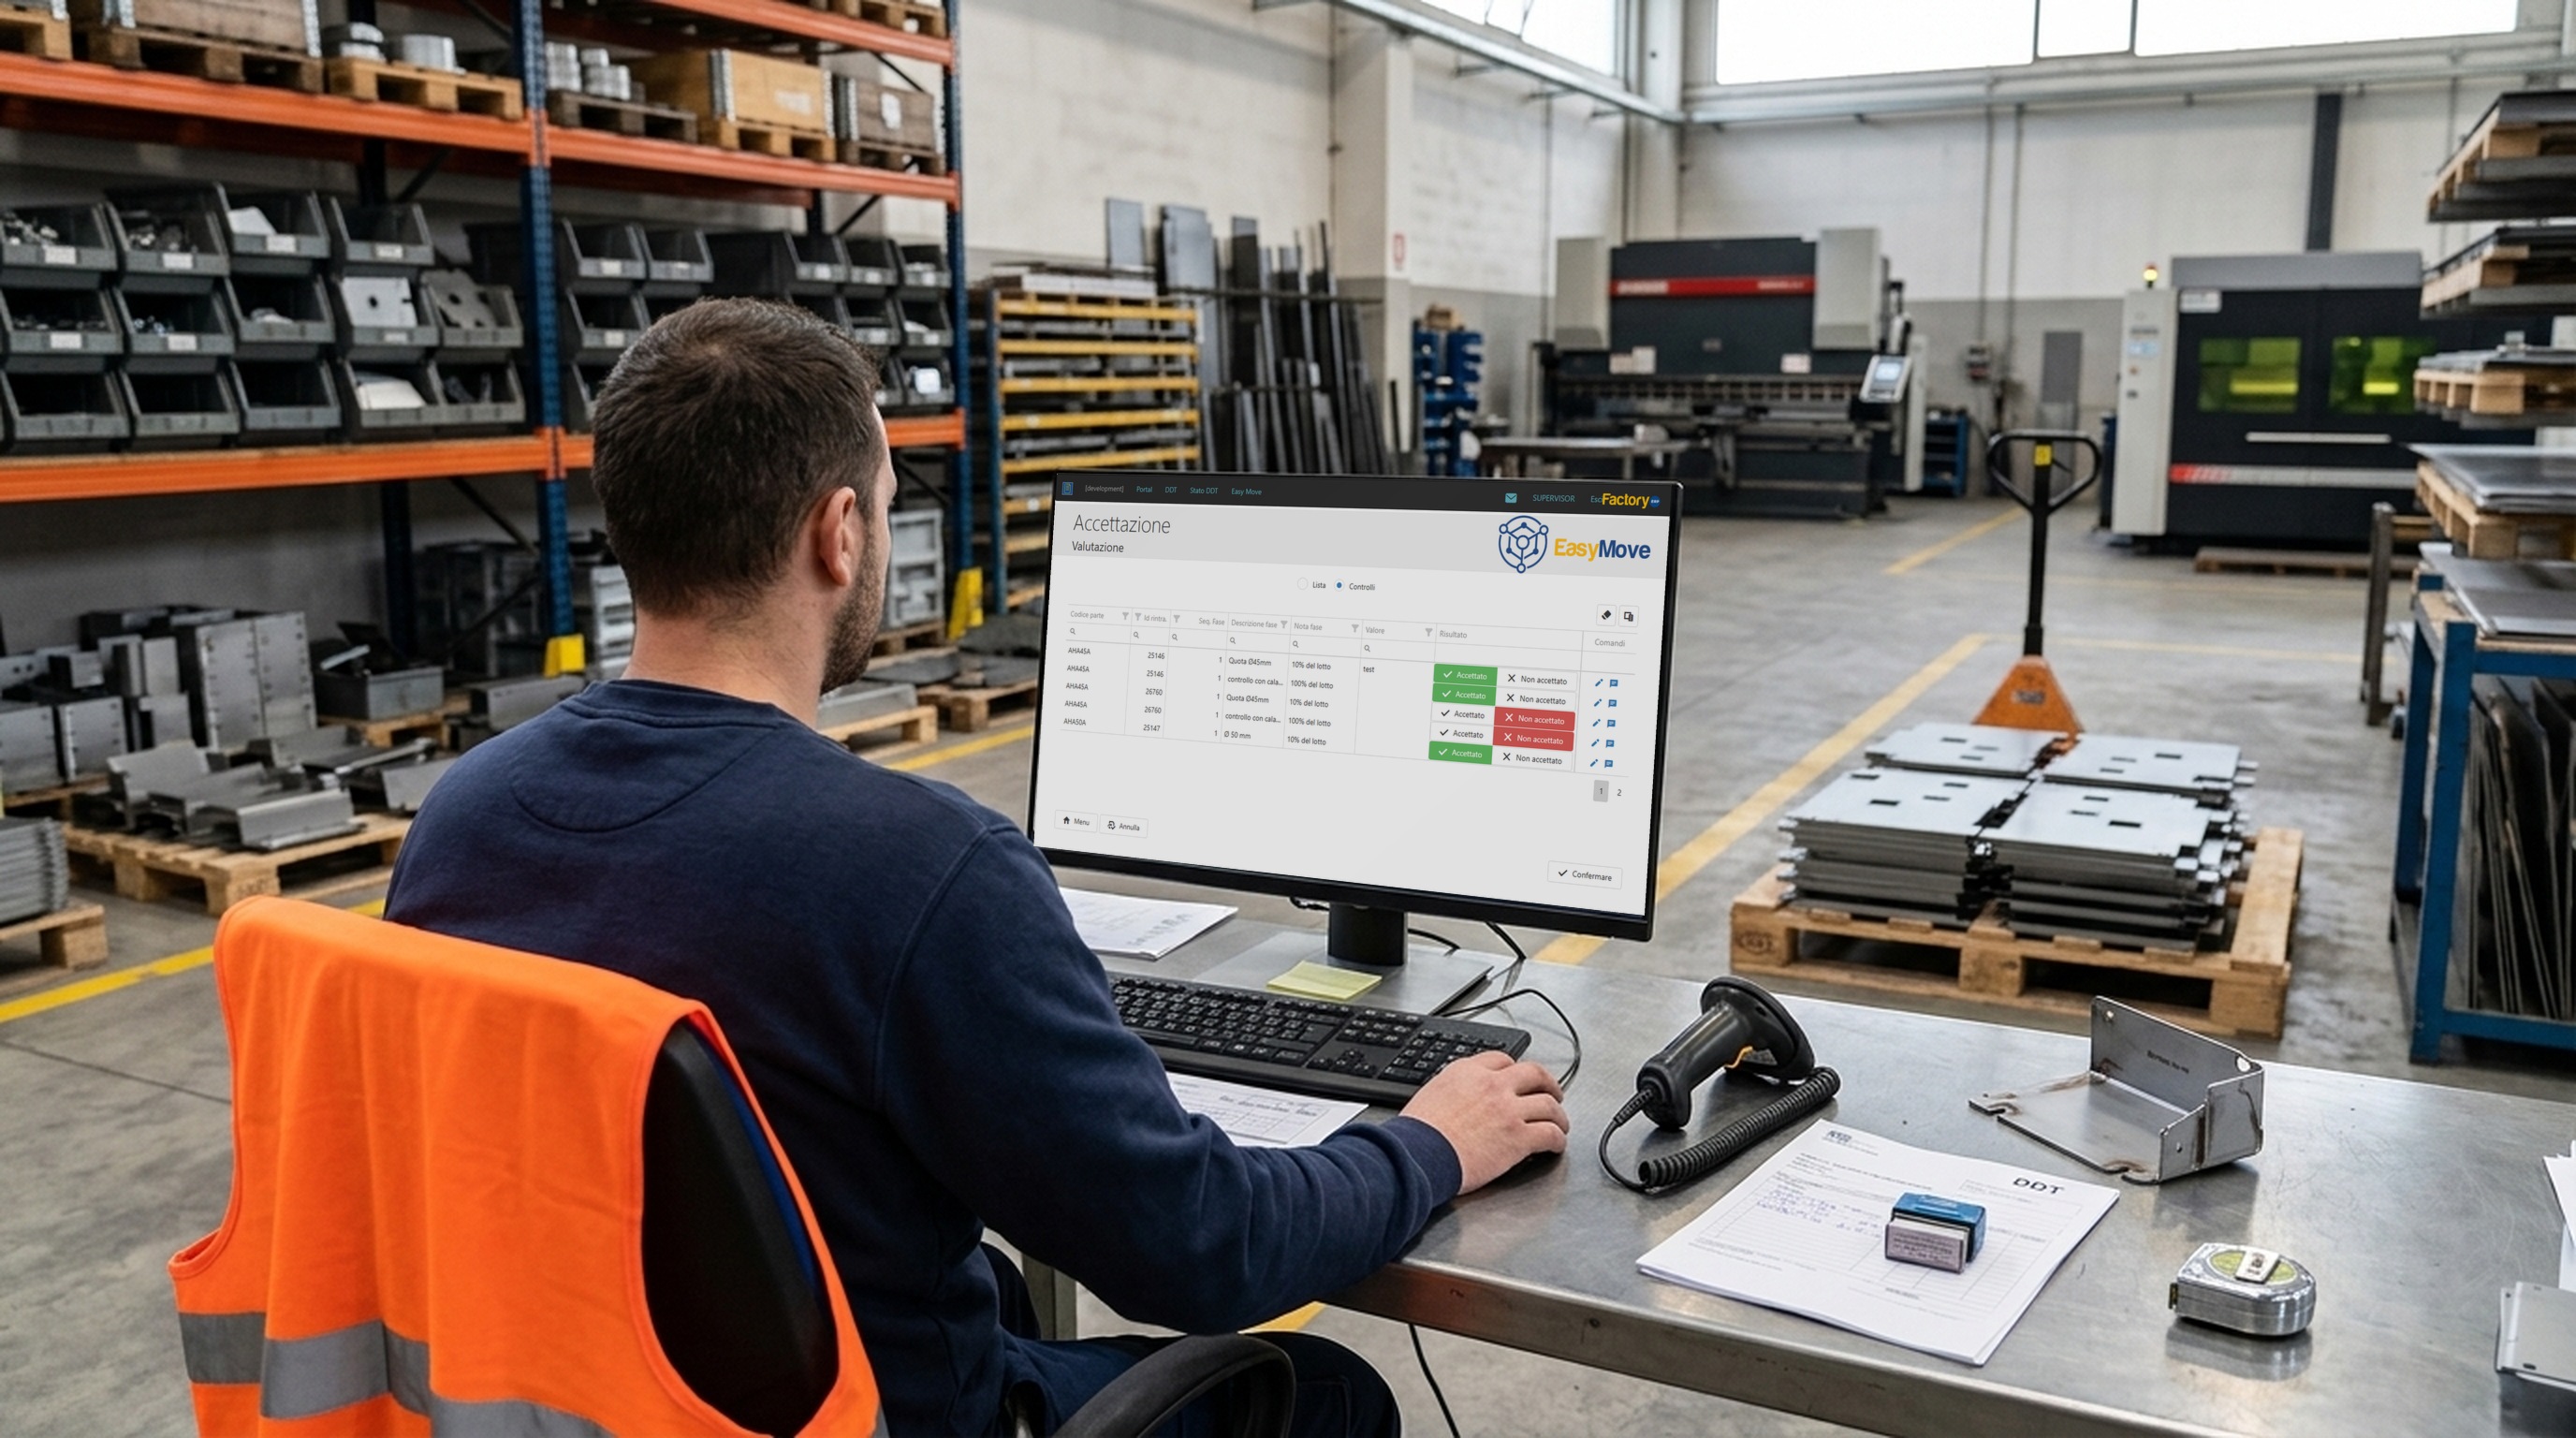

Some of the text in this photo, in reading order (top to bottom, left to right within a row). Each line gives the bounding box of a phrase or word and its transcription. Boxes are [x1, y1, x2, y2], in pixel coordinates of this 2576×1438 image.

[1085, 485, 1124, 493] [development]
[1231, 488, 1244, 496] Easy
[1532, 494, 1575, 503] SUPERVISOR
[1602, 492, 1650, 509] Factory
[1073, 514, 1171, 534] Accettazione
[1072, 541, 1124, 553] Valutazione
[1090, 611, 1105, 620] parte
[1198, 617, 1211, 625] Seq.
[1231, 619, 1265, 627] Descrizione
[1366, 626, 1385, 635] Valore
[1440, 629, 1468, 639] Risultato
[1594, 638, 1626, 648] Comandi
[1068, 647, 1091, 655] AHA45A
[1148, 652, 1165, 660] 25146
[1228, 657, 1247, 666] Quota
[1066, 665, 1090, 673] AHA45A
[1363, 665, 1375, 673] test
[1227, 676, 1254, 684] controllo
[1456, 671, 1487, 681] Accettato
[1521, 675, 1568, 685] Non accettato
[1065, 682, 1089, 691] AHA45A
[1291, 680, 1307, 688] 100%
[1308, 681, 1318, 689] del
[1226, 694, 1245, 703] Quota
[1455, 690, 1486, 700] Accettato
[1519, 695, 1566, 706] Non accettato
[1144, 706, 1162, 714] 26760
[1224, 712, 1251, 722] controllo
[1454, 710, 1486, 720] Accettato
[1288, 717, 1331, 727] 100% del lotto
[1518, 714, 1565, 726] Non accettato
[1453, 729, 1484, 740] Accettato
[1517, 734, 1564, 745] Non accettato
[1451, 749, 1483, 759] Accettato
[1515, 754, 1562, 765] Non accettato
[1617, 788, 1622, 797] 2
[1074, 817, 1090, 826] Menu
[1119, 822, 1140, 831] Annulla
[1573, 871, 1612, 881] Confermare
[2012, 1177, 2064, 1195] DDT
